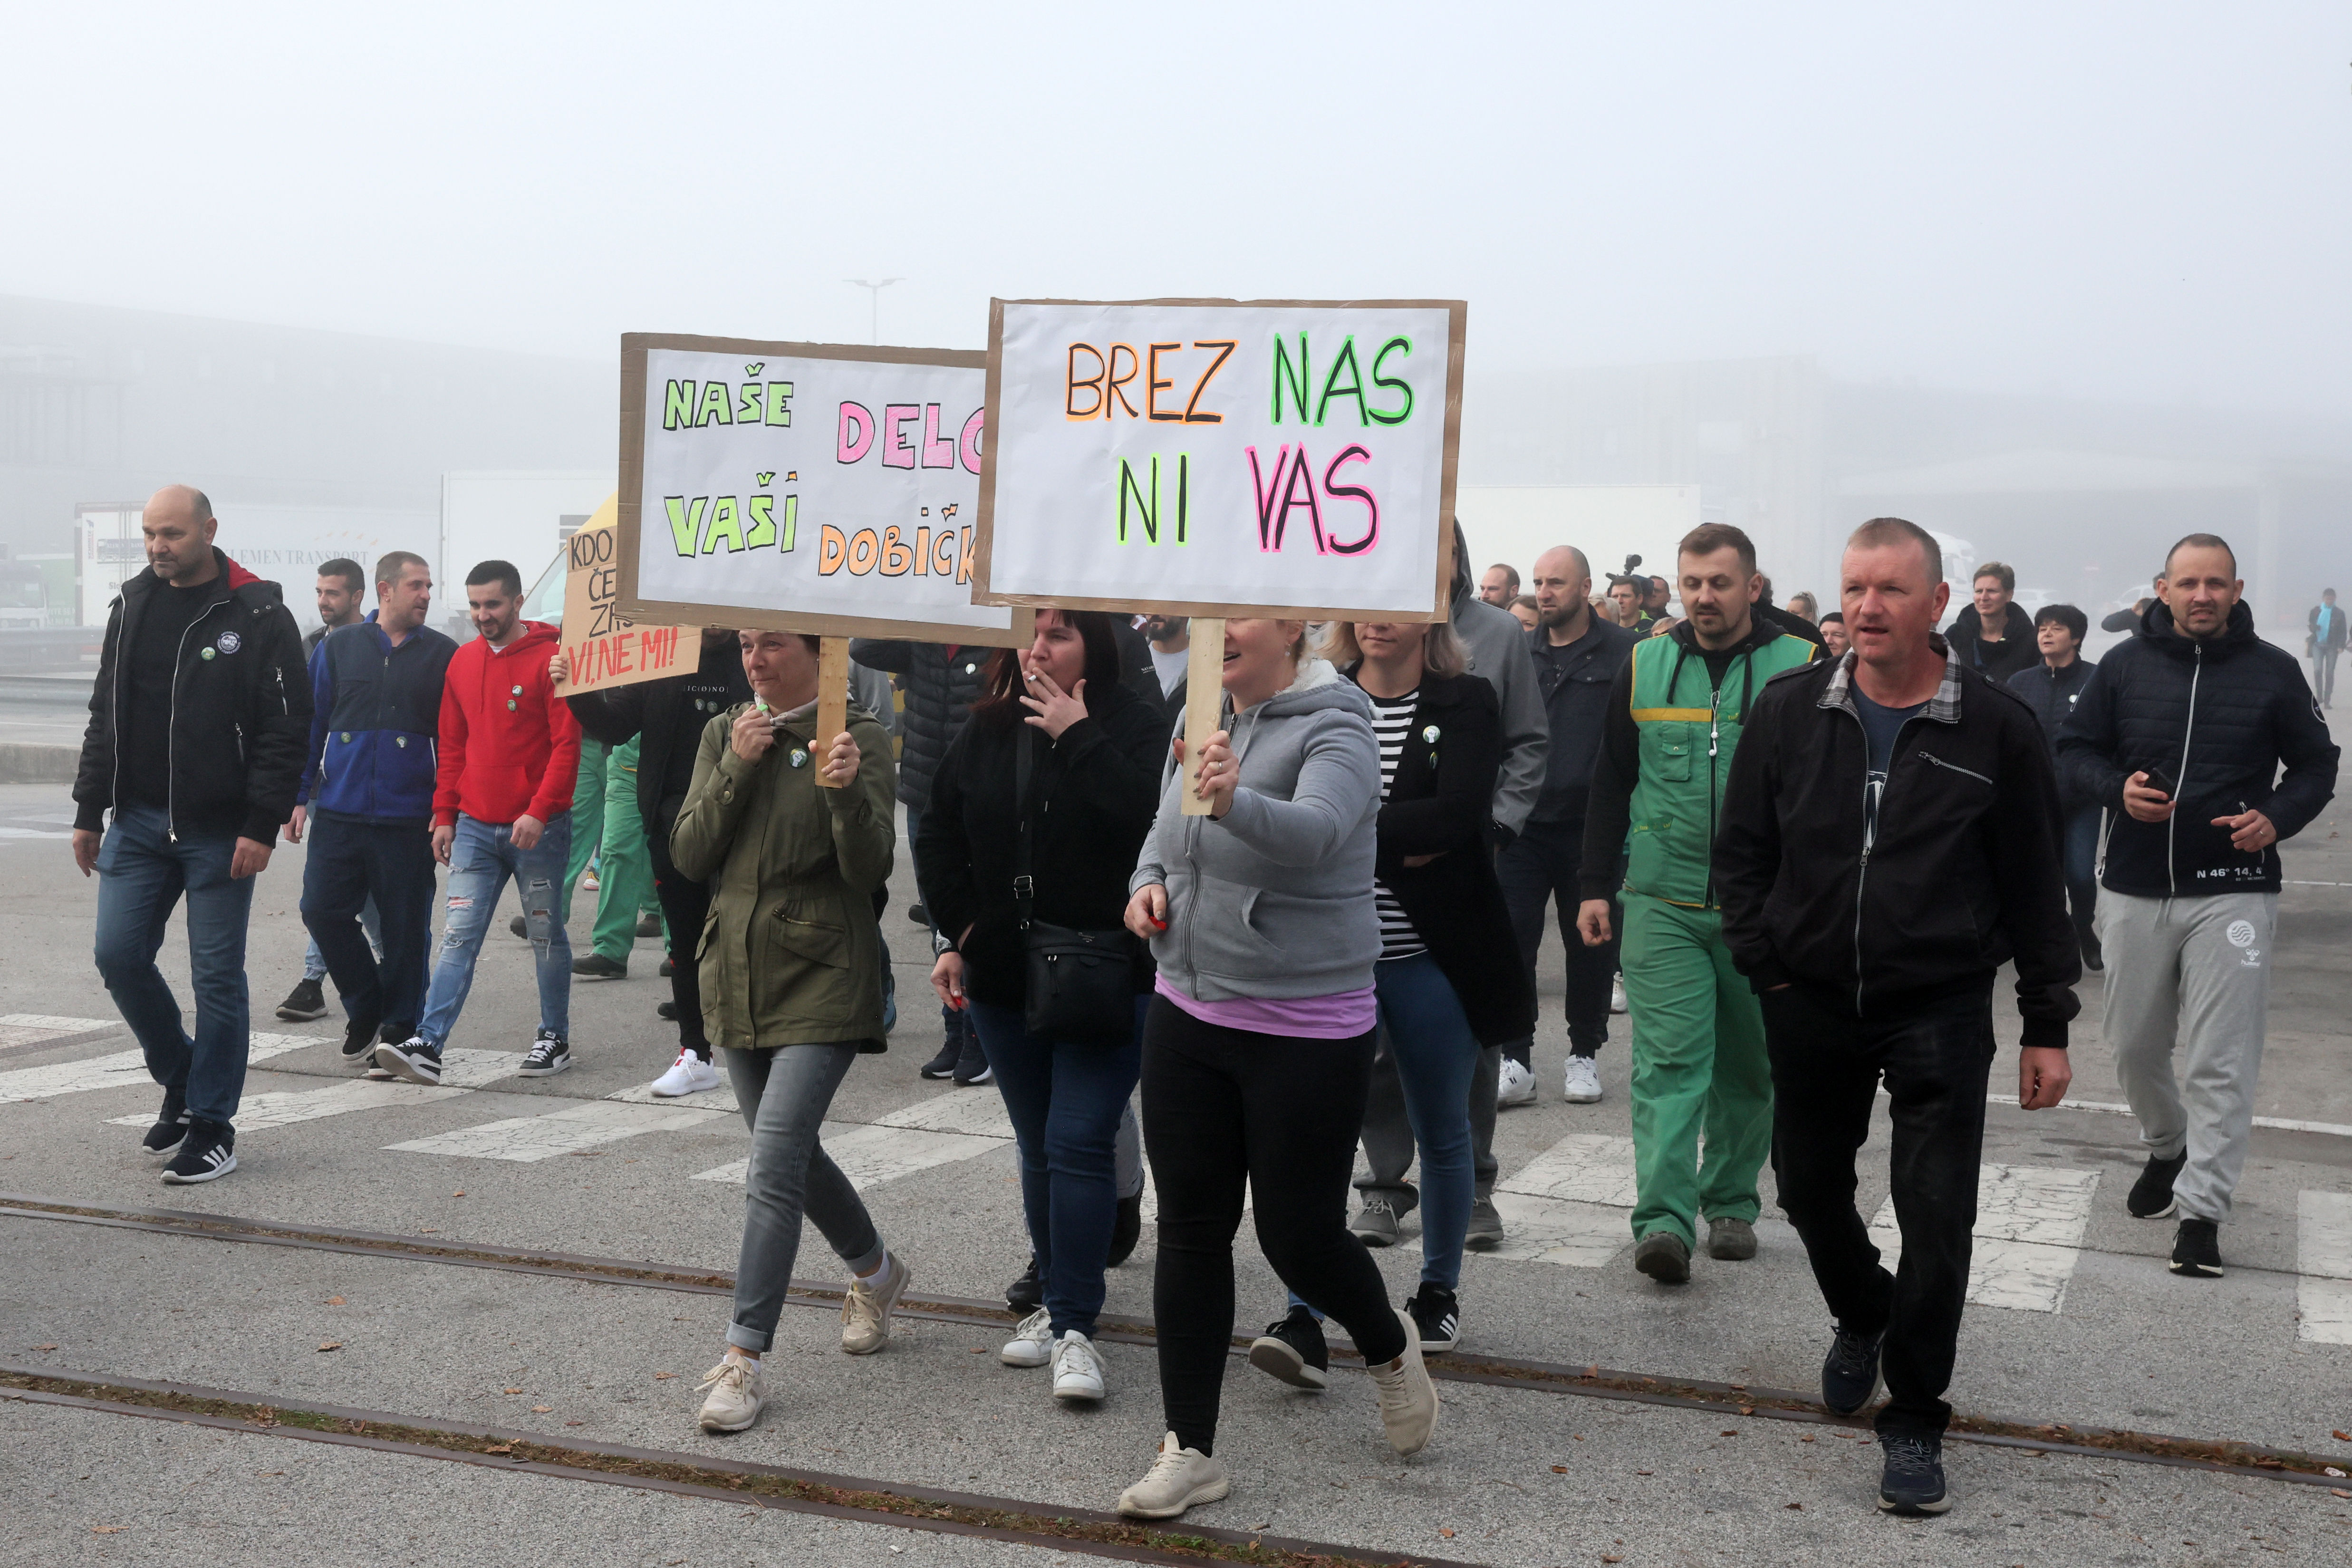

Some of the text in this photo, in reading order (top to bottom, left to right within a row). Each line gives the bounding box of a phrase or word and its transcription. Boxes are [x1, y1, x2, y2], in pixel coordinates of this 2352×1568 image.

[663, 362, 794, 430] NAŠE
[1065, 331, 1415, 427] BREZ NAS
[837, 401, 985, 475] DELO
[1116, 441, 1380, 556] NI VAS
[570, 529, 612, 570] KDO
[818, 504, 976, 585] DOBIČK
[641, 626, 677, 672] MI!
[2197, 870, 2206, 878] N
[2210, 868, 2230, 877] 46°
